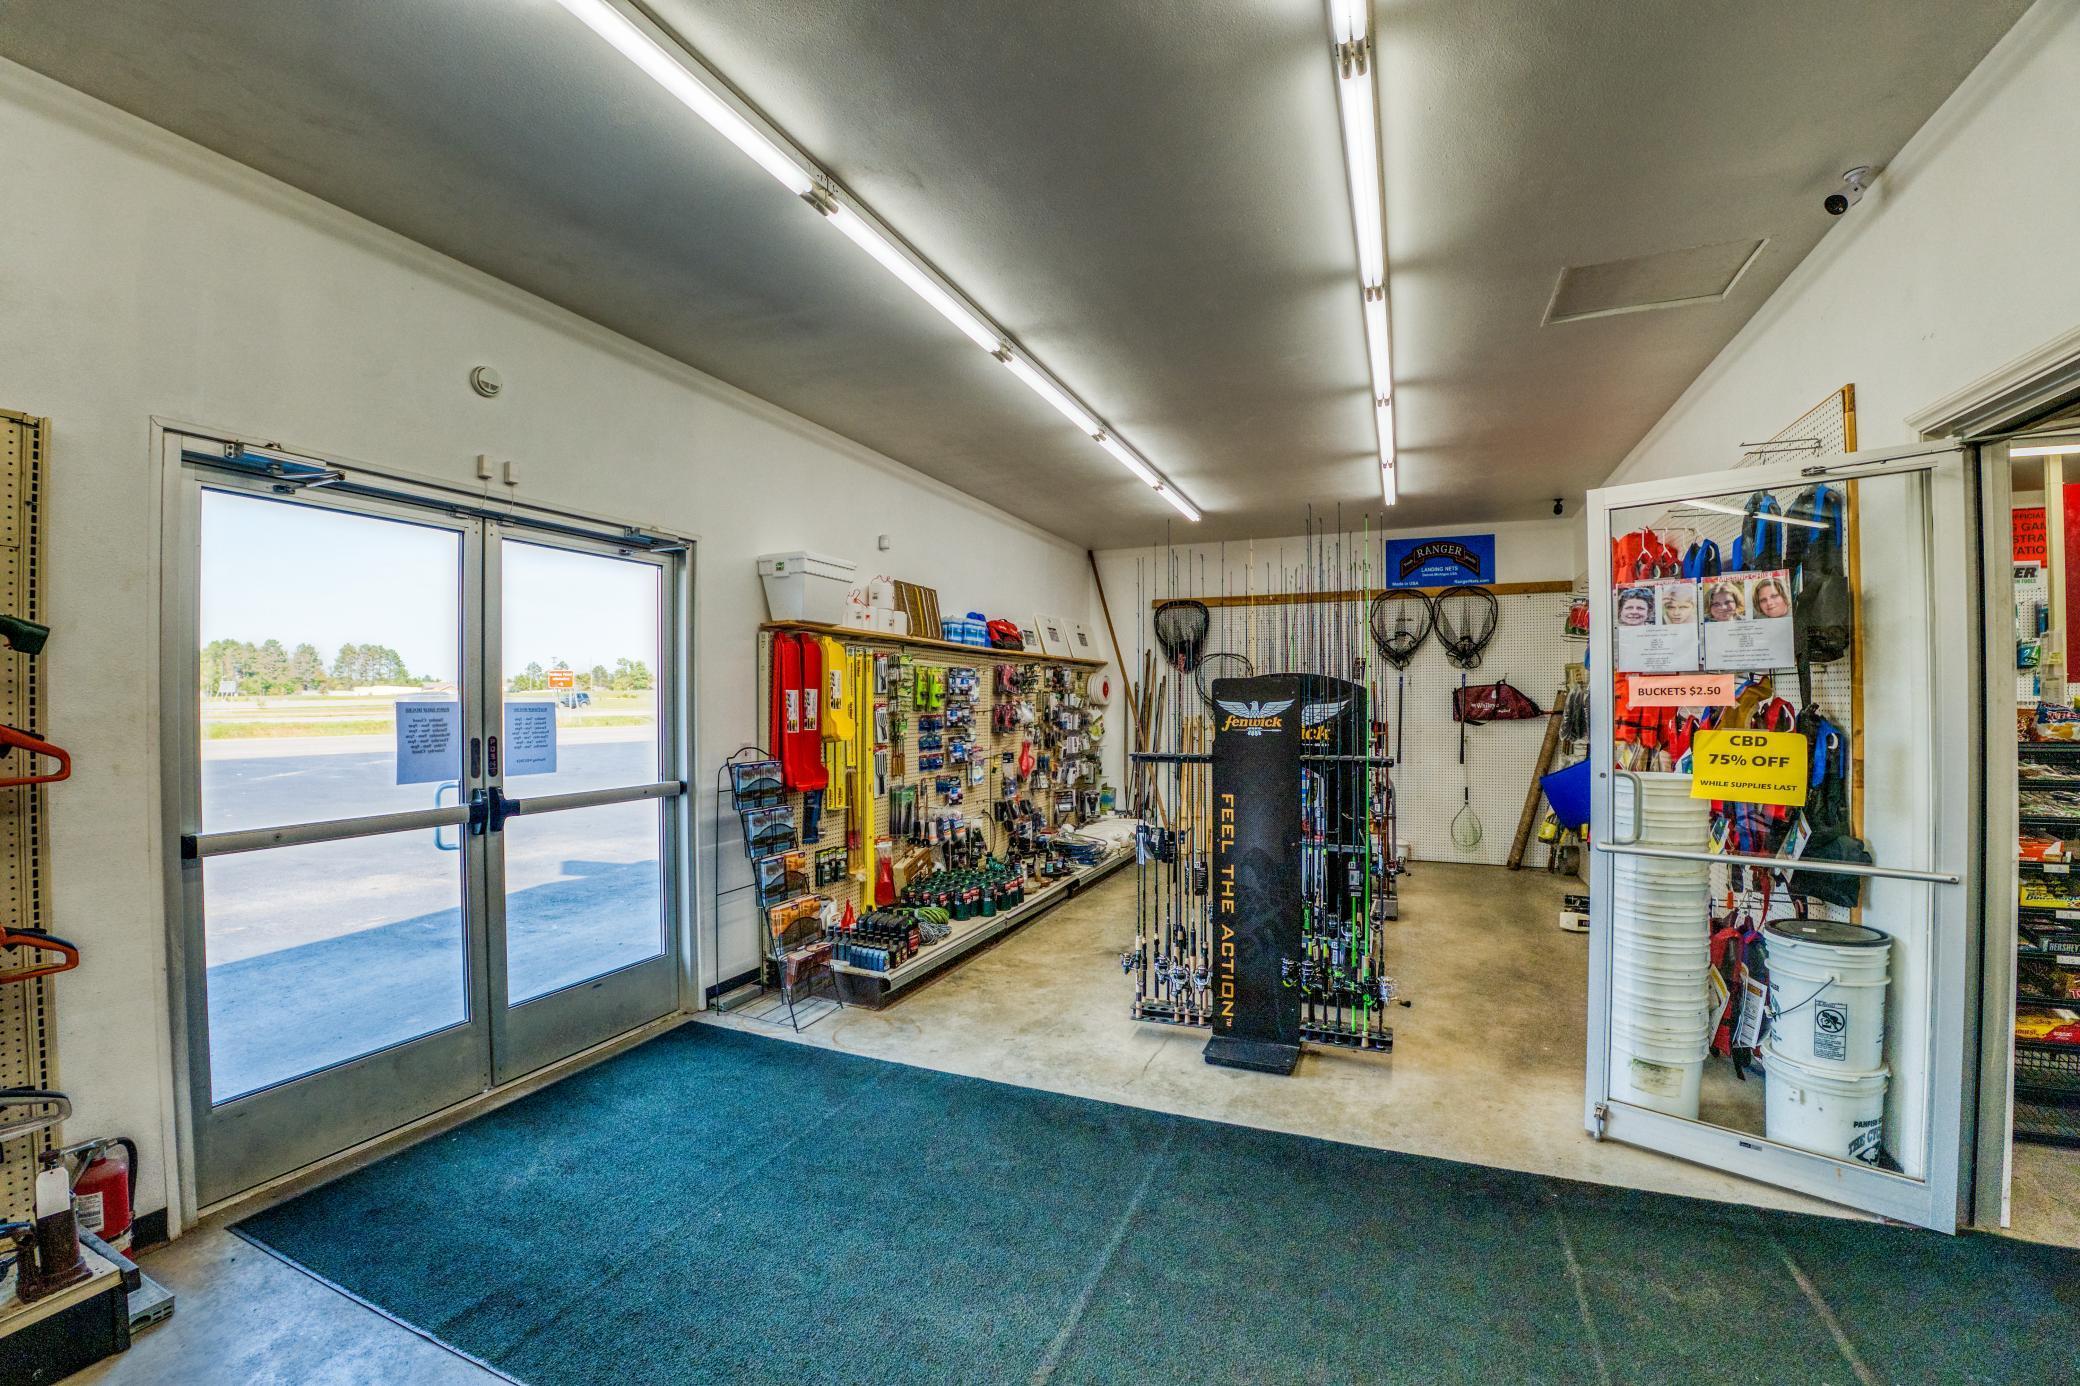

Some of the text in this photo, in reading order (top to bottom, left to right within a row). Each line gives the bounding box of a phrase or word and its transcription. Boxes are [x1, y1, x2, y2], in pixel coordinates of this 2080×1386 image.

[1417, 544, 1462, 558] RANGER
[2014, 567, 2037, 578] ER
[1638, 685, 1721, 696] BUCKETS $2.50
[1221, 714, 1282, 732] fenwick
[1729, 735, 1768, 747] CBD
[1708, 753, 1790, 768] 75% OFF
[1700, 779, 1729, 787] WHILE
[1730, 781, 1772, 790] SUPPLIES
[1221, 793, 1235, 854] FEEL
[1221, 864, 1235, 914] THE
